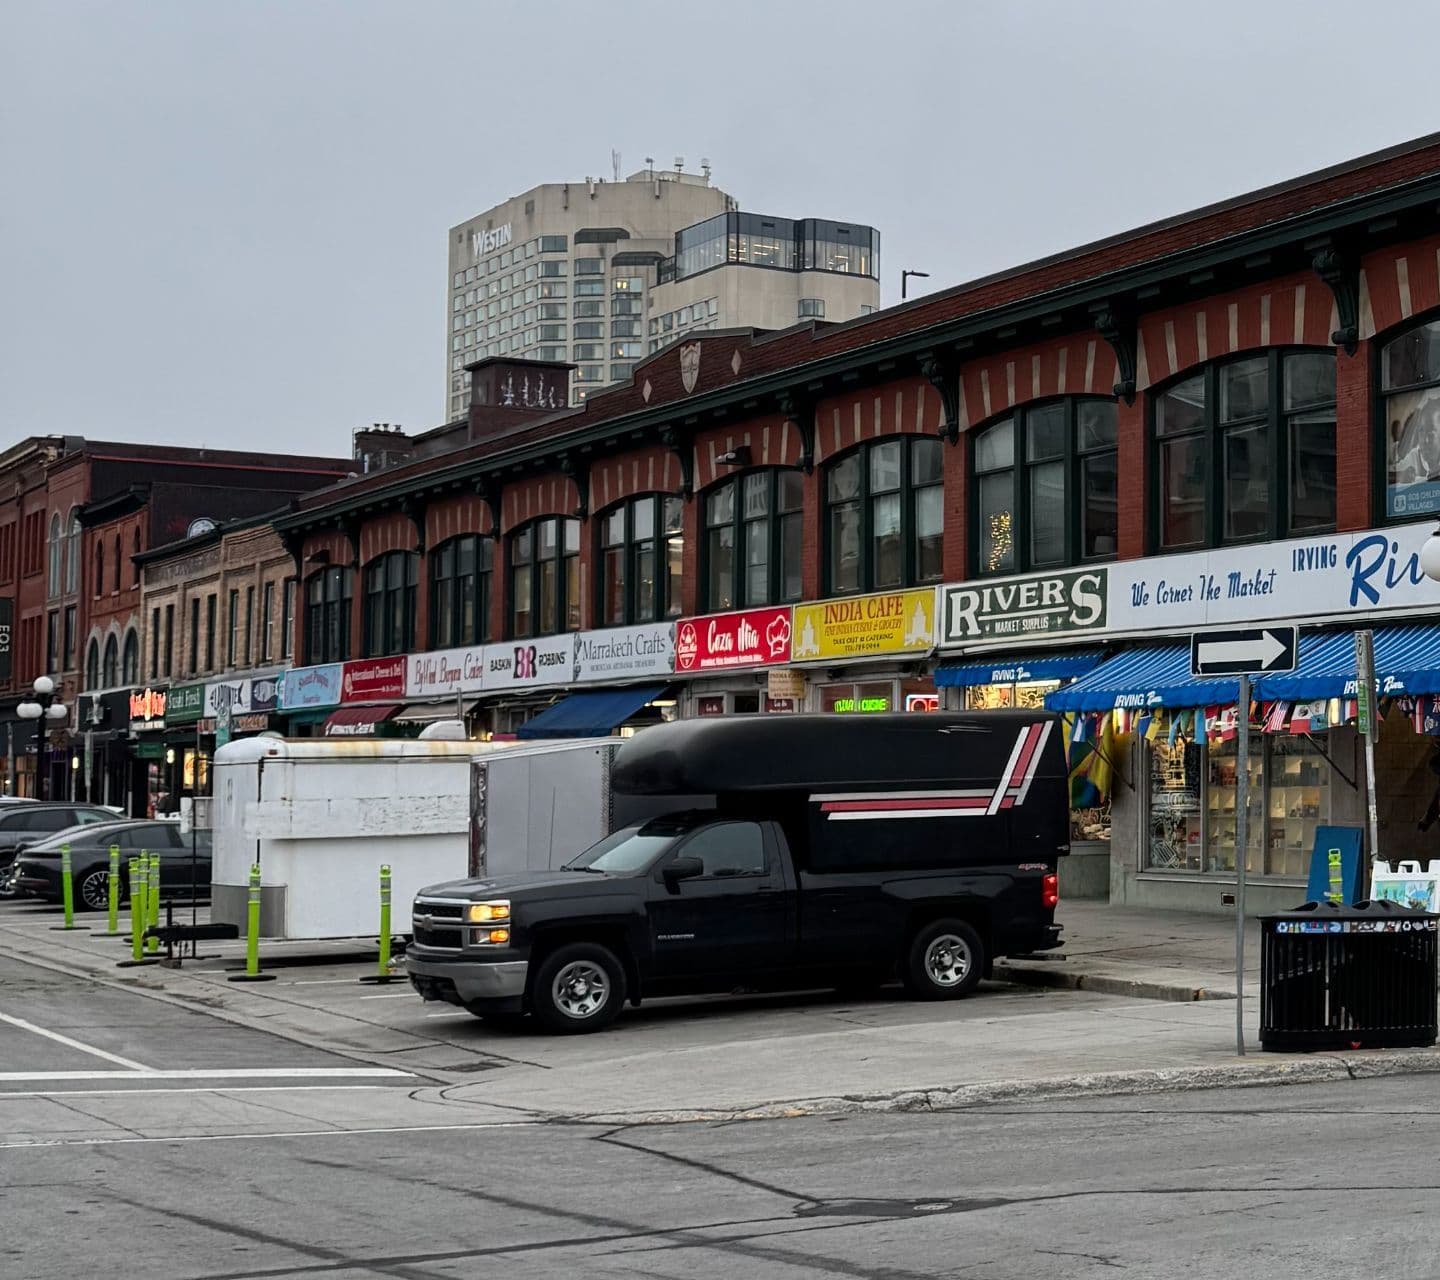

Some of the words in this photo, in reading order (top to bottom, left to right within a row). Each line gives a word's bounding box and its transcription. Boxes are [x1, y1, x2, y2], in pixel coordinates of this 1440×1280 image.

[472, 221, 512, 257] WESTIN
[1292, 544, 1338, 572] IRVING
[1131, 580, 1149, 607] We
[1156, 579, 1193, 605] Corner
[1200, 574, 1221, 601] The
[1228, 568, 1277, 599] Market
[824, 600, 863, 625] INDIA
[867, 594, 904, 619] CAFE
[949, 574, 1103, 637] RIVERS
[995, 619, 1020, 634] MARKET
[1022, 616, 1049, 631] SURPLUS
[582, 634, 633, 661] Marrakech
[635, 631, 666, 656] Crafts
[490, 658, 512, 672] BASKIN
[513, 645, 537, 679] BR
[538, 651, 567, 667] ROBBINS
[991, 669, 1015, 681] IRVING
[1114, 694, 1145, 708] IRVING
